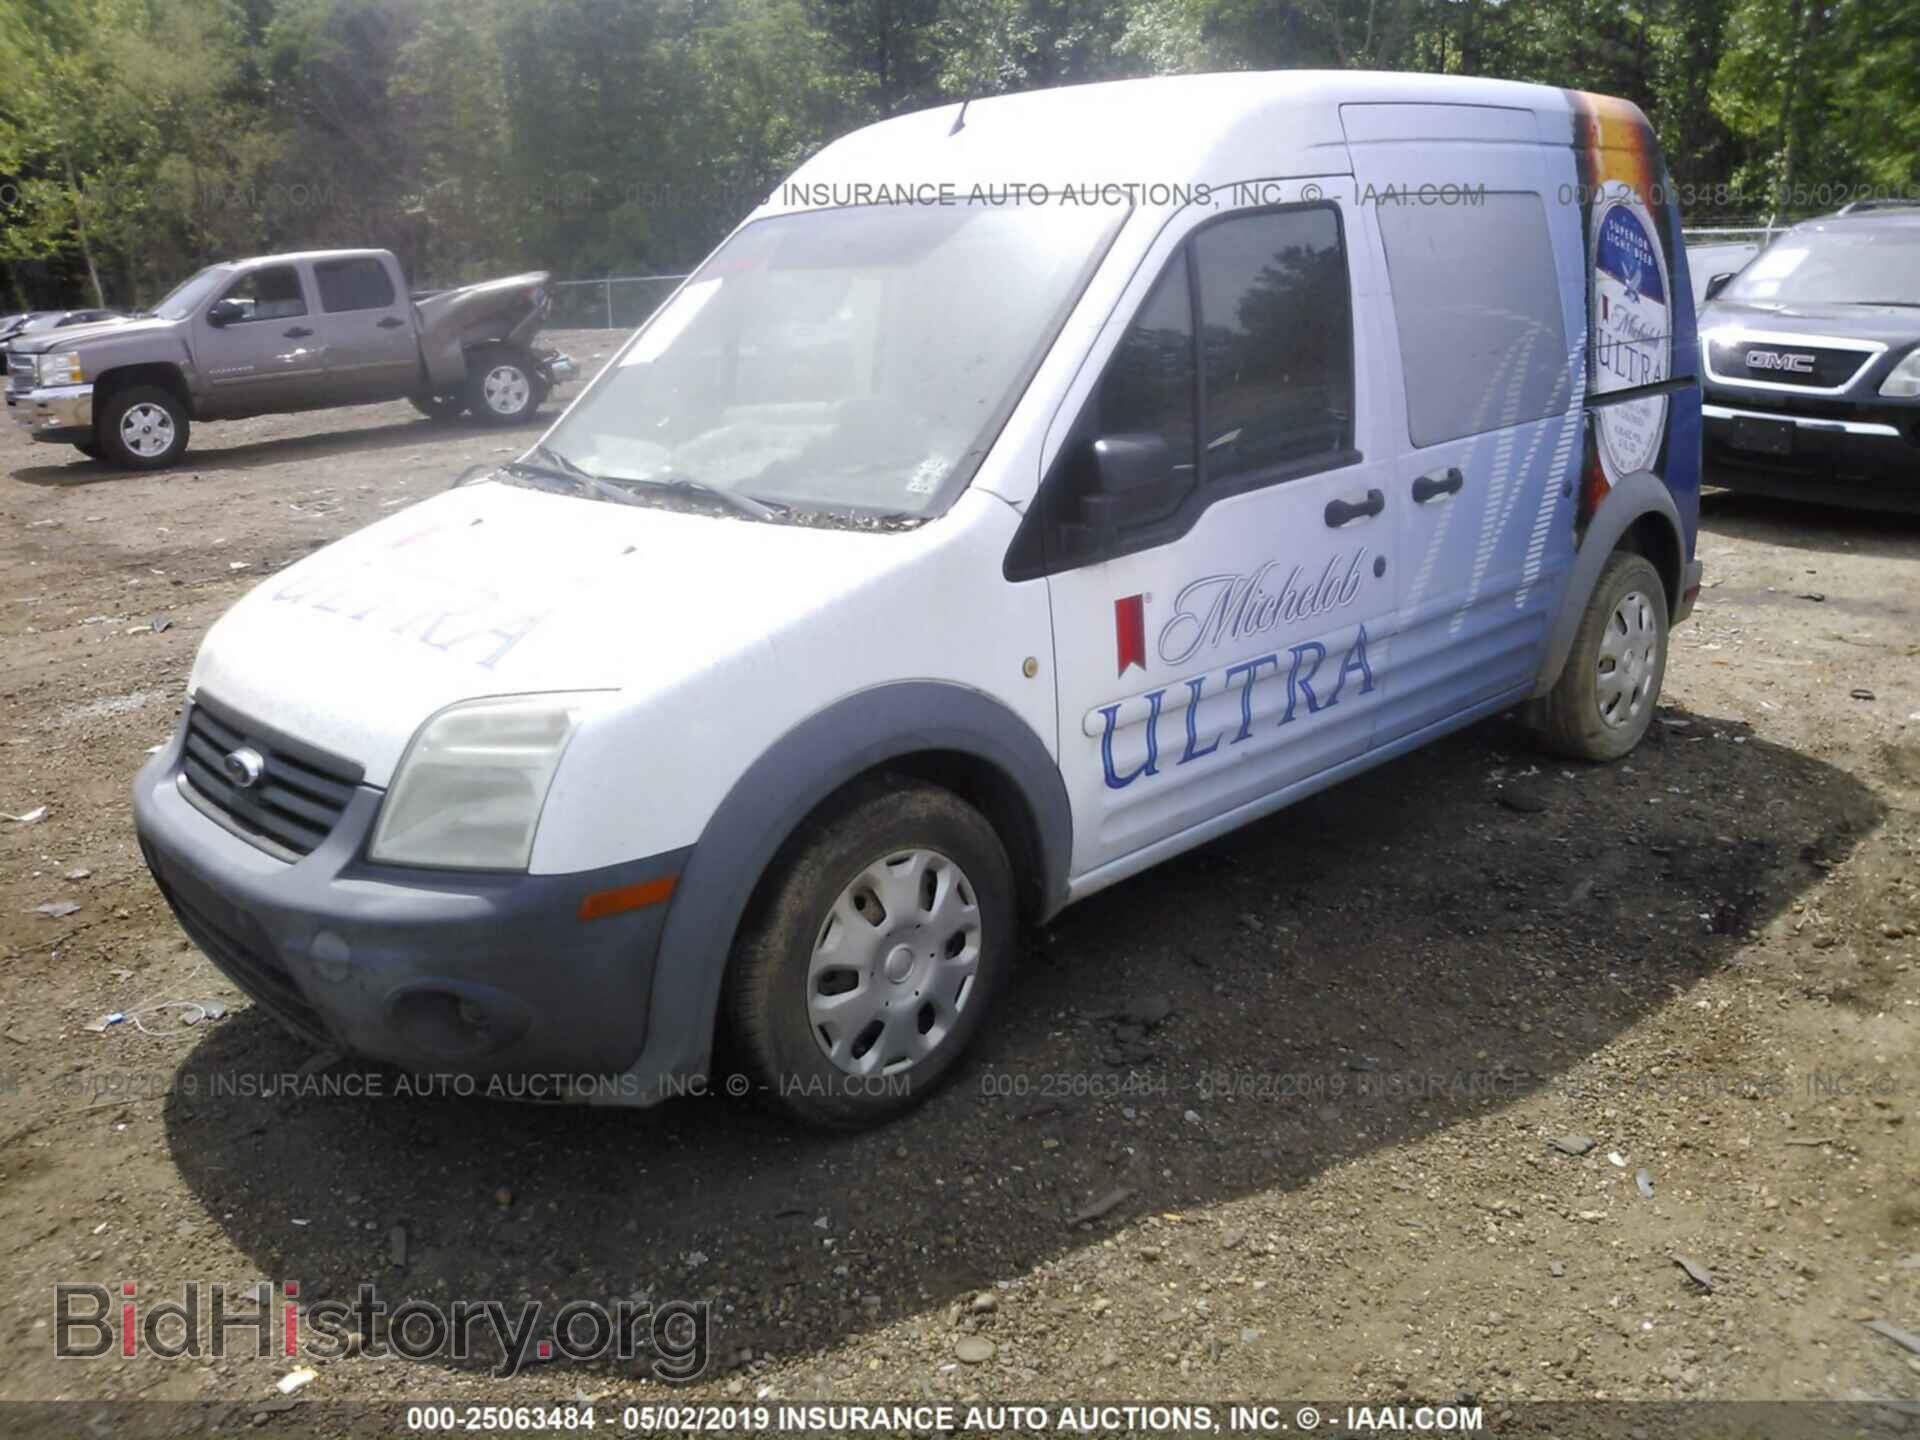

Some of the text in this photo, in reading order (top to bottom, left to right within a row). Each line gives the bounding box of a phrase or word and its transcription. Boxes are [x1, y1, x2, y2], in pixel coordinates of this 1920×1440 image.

[1598, 328, 1663, 385] ULTRA
[1745, 350, 1816, 373] GMC
[1158, 547, 1368, 667] Michelob
[1098, 623, 1375, 790] ULTRA
